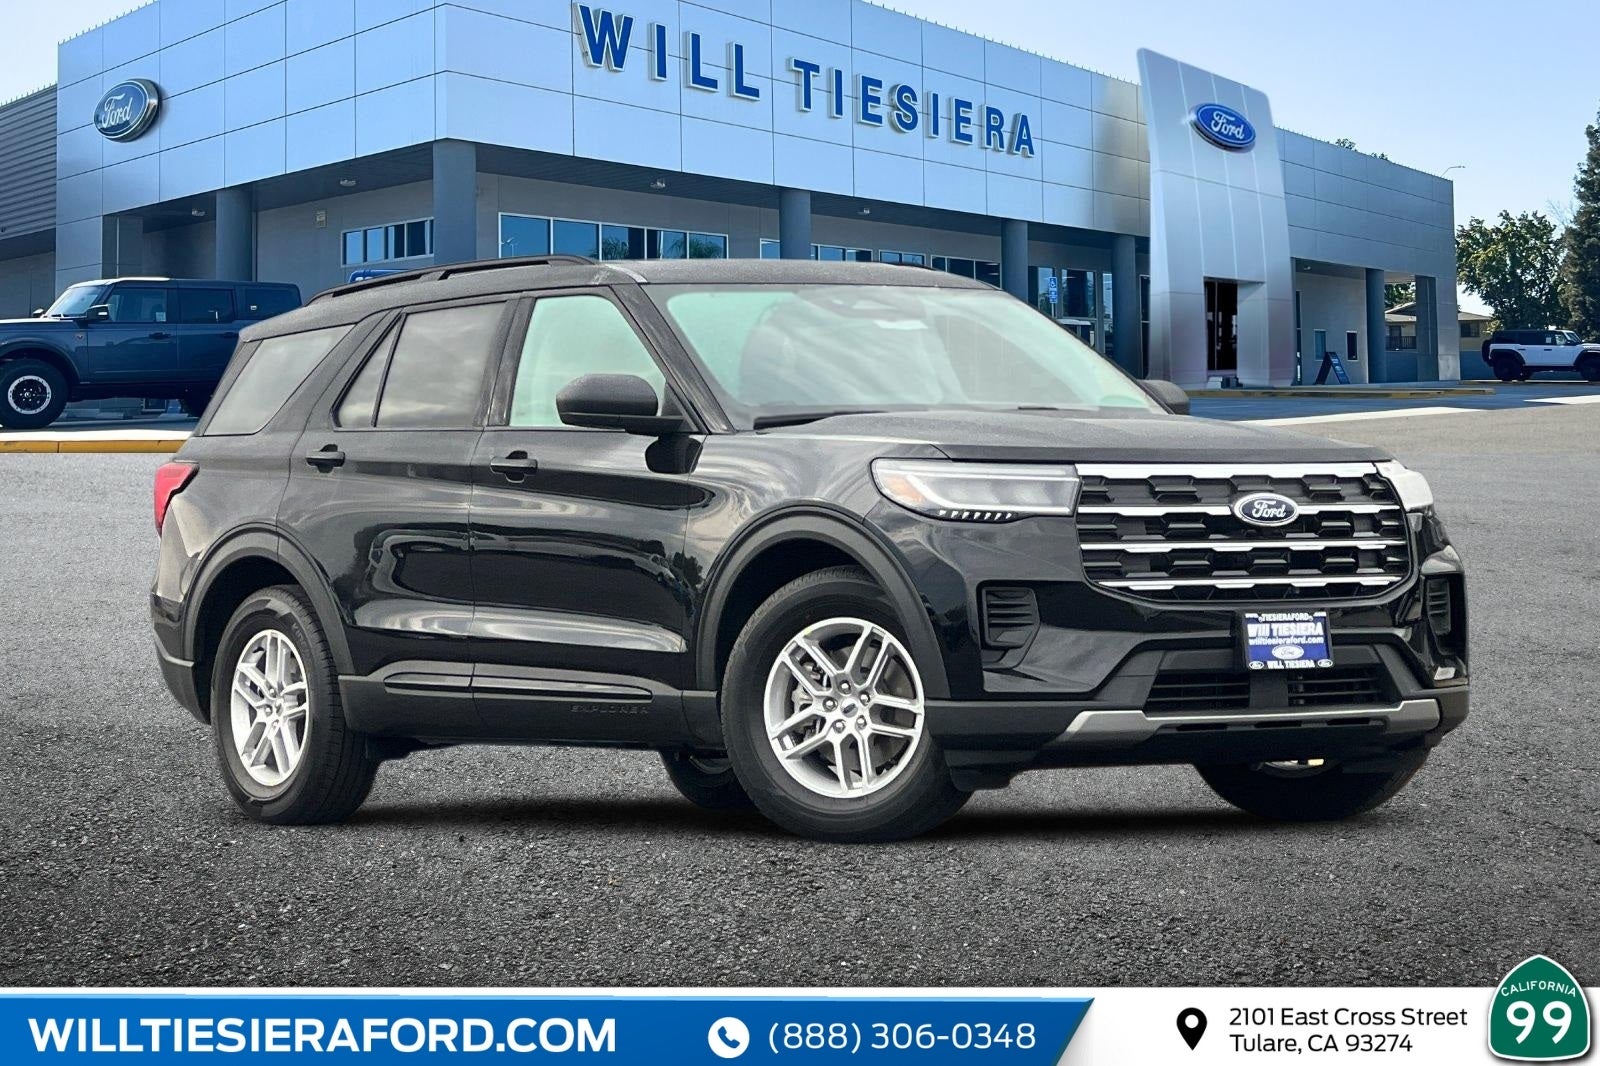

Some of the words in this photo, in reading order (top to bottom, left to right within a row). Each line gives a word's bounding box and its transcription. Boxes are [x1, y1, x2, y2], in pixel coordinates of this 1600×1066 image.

[573, 2, 761, 101] WILL
[788, 56, 1036, 158] TIESIERA
[101, 93, 133, 129] Ford
[1211, 110, 1245, 140] Ford
[1251, 500, 1287, 518] Ford
[1271, 622, 1324, 636] TIESIERA
